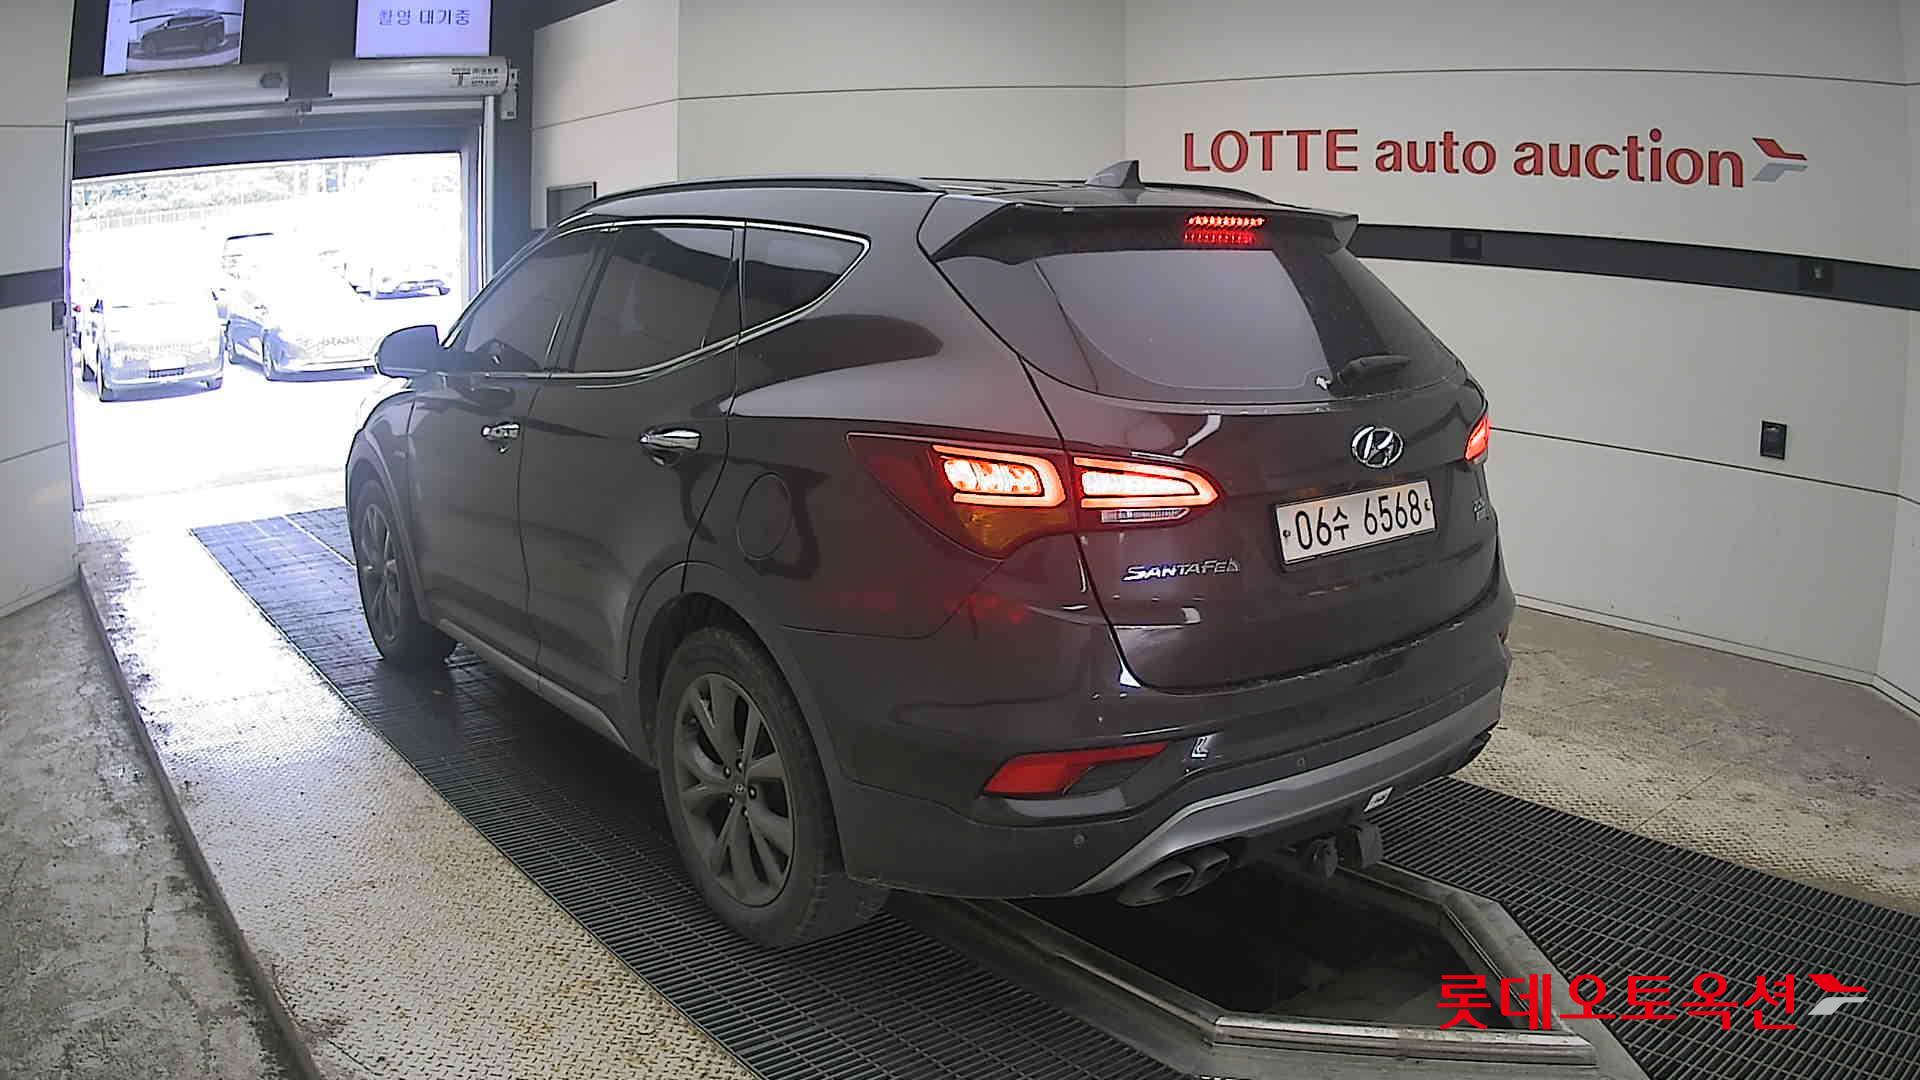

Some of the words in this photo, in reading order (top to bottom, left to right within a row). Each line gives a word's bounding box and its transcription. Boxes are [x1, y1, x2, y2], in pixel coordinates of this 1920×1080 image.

[419, 9, 471, 26] 대기중
[1184, 129, 1358, 173] LOTTE
[1375, 131, 1497, 176] auto
[1513, 128, 1744, 188] auction
[1295, 506, 1350, 550] 06수
[1364, 489, 1422, 535] 6568
